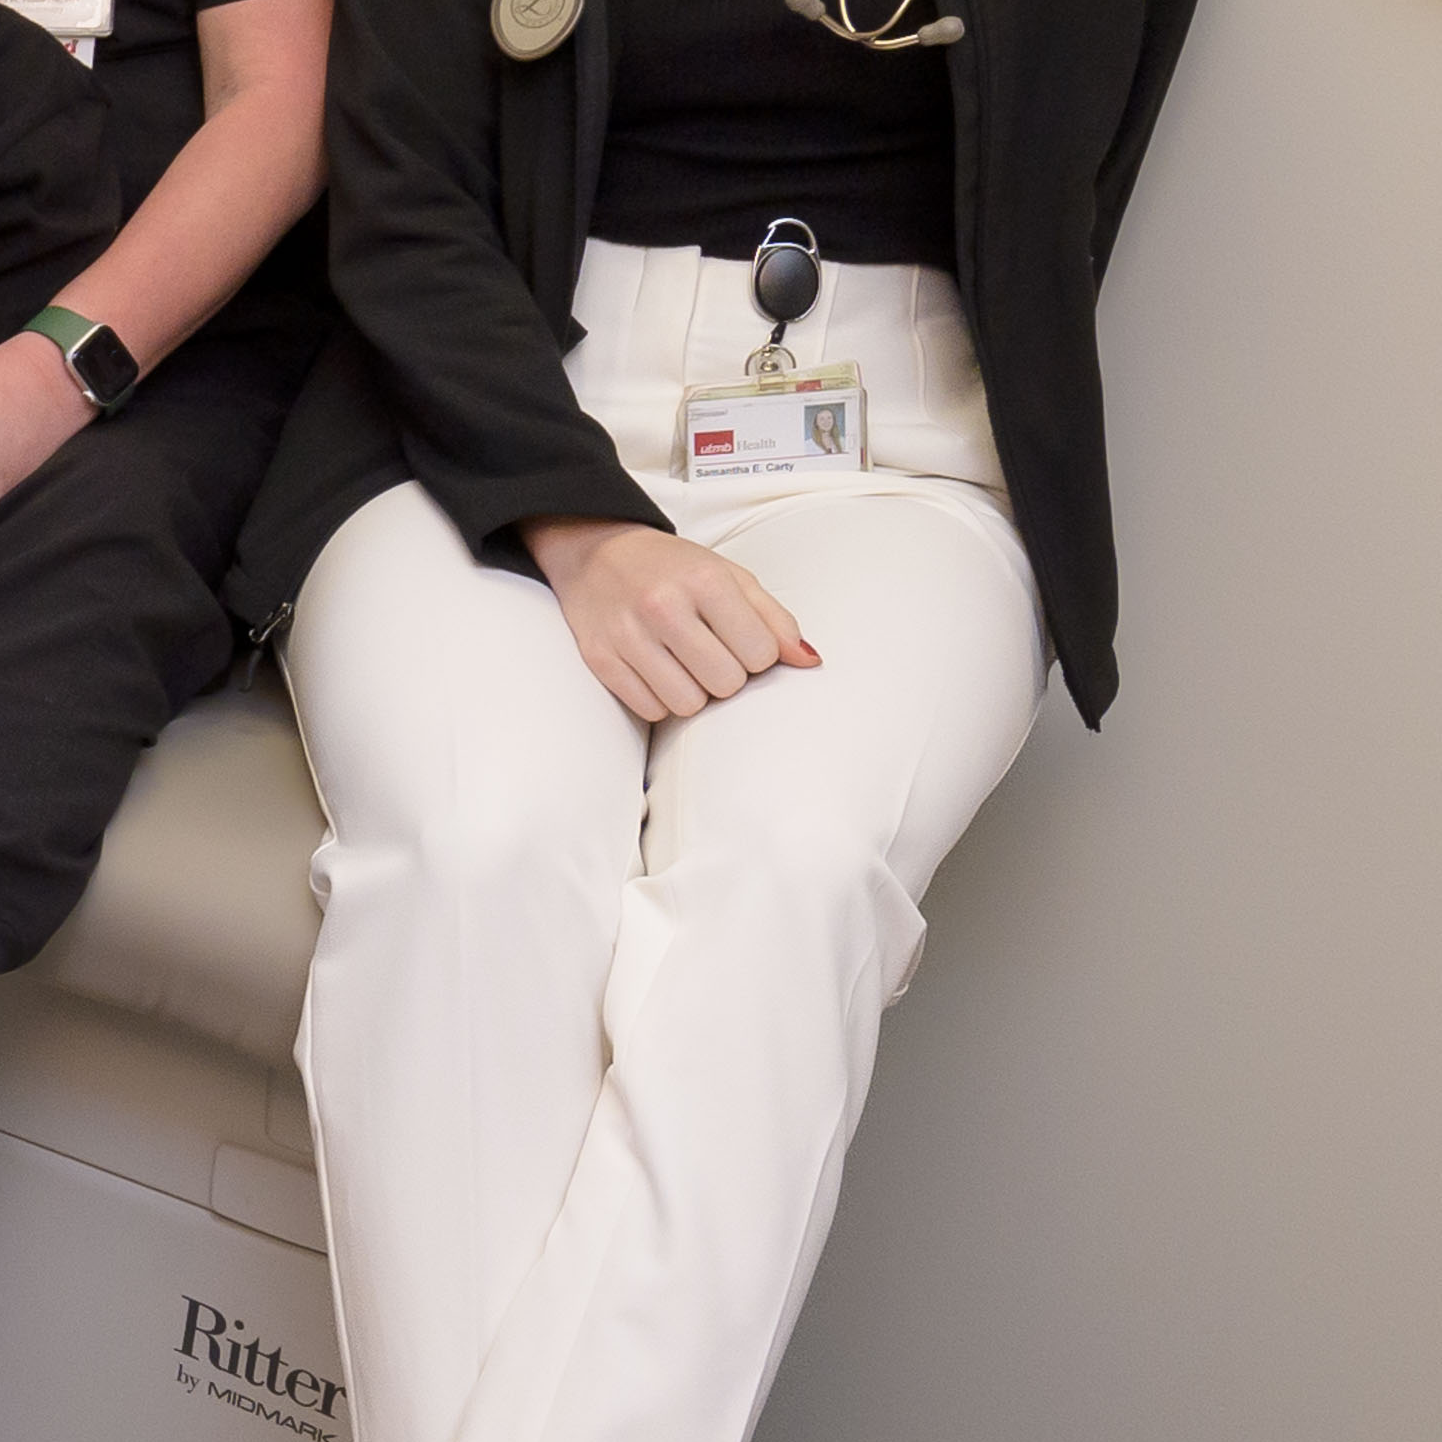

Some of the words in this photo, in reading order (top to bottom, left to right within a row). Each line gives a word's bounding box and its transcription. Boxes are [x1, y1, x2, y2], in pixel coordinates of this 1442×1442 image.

[699, 442, 734, 455] utmb
[736, 438, 777, 452] Health
[695, 465, 750, 479] Samantha
[765, 461, 796, 474] Carty
[173, 1295, 347, 1420] Ritter
[176, 1363, 202, 1395] by
